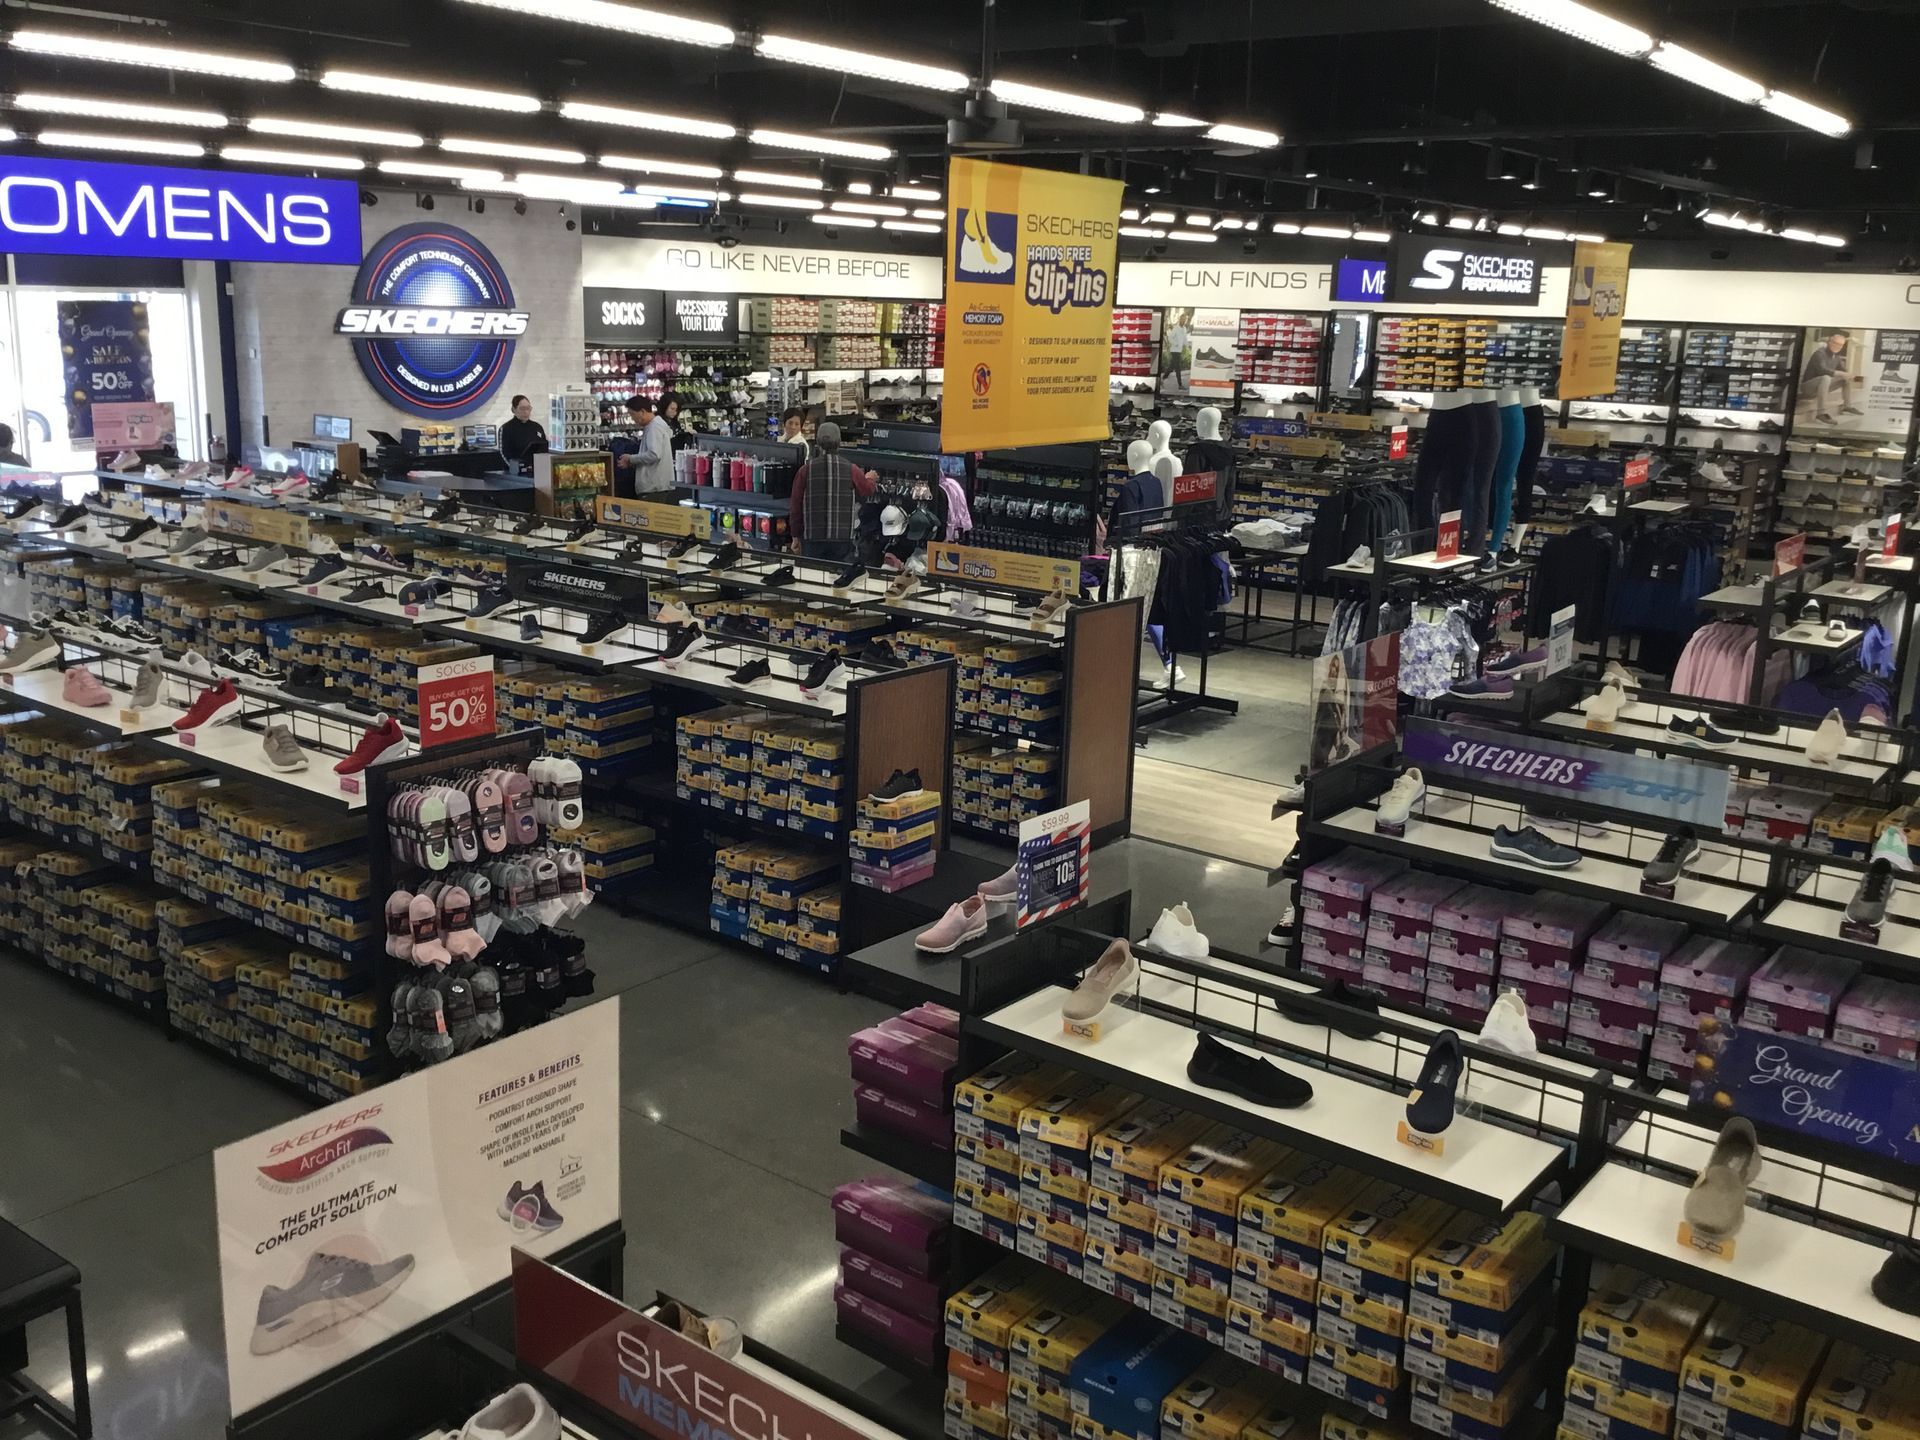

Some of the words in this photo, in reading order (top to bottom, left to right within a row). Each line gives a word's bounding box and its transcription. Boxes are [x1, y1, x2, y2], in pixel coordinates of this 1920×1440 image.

[1026, 214, 1114, 240] SKECHERS
[666, 248, 701, 269] GO
[710, 251, 755, 272] LIKE
[762, 254, 831, 276] NEVER
[837, 258, 911, 279] BEFORE
[1026, 245, 1064, 262] HANDS
[1066, 246, 1092, 261] FREE
[382, 280, 394, 296] THE
[390, 253, 419, 281] COMFORT
[418, 250, 465, 268] TECHNOLOGY
[464, 264, 491, 300] COMPANY
[1169, 270, 1221, 288] FUN
[1230, 271, 1308, 289] FINDS
[1463, 255, 1534, 279] SKECHERS
[1027, 262, 1107, 309] Slip-ins
[1461, 276, 1532, 294] PERFORMANCE
[601, 301, 645, 326] SOCKS
[675, 299, 728, 318] ACCESSORIZE
[965, 314, 987, 324] MEMORY
[987, 314, 1003, 324] FOAM
[340, 309, 529, 336] SKECHERS
[680, 315, 702, 332] YOUR
[703, 316, 724, 332] LOOK
[1028, 357, 1041, 365] JUST
[1041, 357, 1053, 365] STEP
[396, 364, 430, 391] DESIGNED
[430, 384, 438, 393] IN
[440, 383, 454, 393] LOS
[455, 363, 484, 390] ANGELES
[1027, 376, 1053, 384] EXCLUSIVE
[1175, 480, 1196, 495] SALE
[543, 571, 606, 591] SKECHERS
[963, 562, 997, 579] Slip-ins
[436, 661, 477, 678] SOCKS
[429, 694, 442, 702] BUY
[442, 691, 457, 699] ONE
[457, 688, 470, 697] GET
[471, 685, 485, 693] ONE
[469, 714, 486, 724] OFF
[1444, 741, 1584, 785] SKECHERS
[1041, 812, 1070, 832] $59.99
[1749, 1041, 1843, 1091] Grand
[478, 1076, 526, 1105] FEATURES
[528, 1072, 535, 1083] &
[538, 1054, 581, 1080] BENEFITS
[489, 1099, 525, 1122] PODIATRIST
[525, 1087, 556, 1107] DESIGNED
[557, 1077, 577, 1093] SHAPE
[495, 1113, 525, 1134] COMFORT
[526, 1106, 543, 1120] ARCH
[544, 1094, 572, 1112] SUPPORT
[1781, 1084, 1884, 1145] Opening
[267, 1103, 384, 1159] SKECHERS
[480, 1139, 502, 1156] SHAPE
[502, 1135, 511, 1145] OF
[511, 1123, 534, 1141] INSOLE
[534, 1117, 550, 1130] WAS
[550, 1102, 585, 1123] DEVELOPED
[487, 1146, 504, 1161] WITH
[504, 1140, 521, 1153] OVER
[522, 1135, 531, 1145] 20
[531, 1125, 552, 1141] YEARS
[552, 1122, 561, 1132] OF
[561, 1115, 576, 1128] DATA
[503, 1149, 532, 1168] MACHINE
[532, 1133, 566, 1155] WASHABLE
[296, 1171, 335, 1195] CERTIFIED
[336, 1157, 357, 1174] ARCH
[358, 1147, 390, 1163] SUPPORT
[280, 1210, 307, 1231] THE
[311, 1180, 376, 1218] ULTIMATE
[255, 1214, 328, 1256] COMFORT
[330, 1184, 398, 1223] SOLUTION
